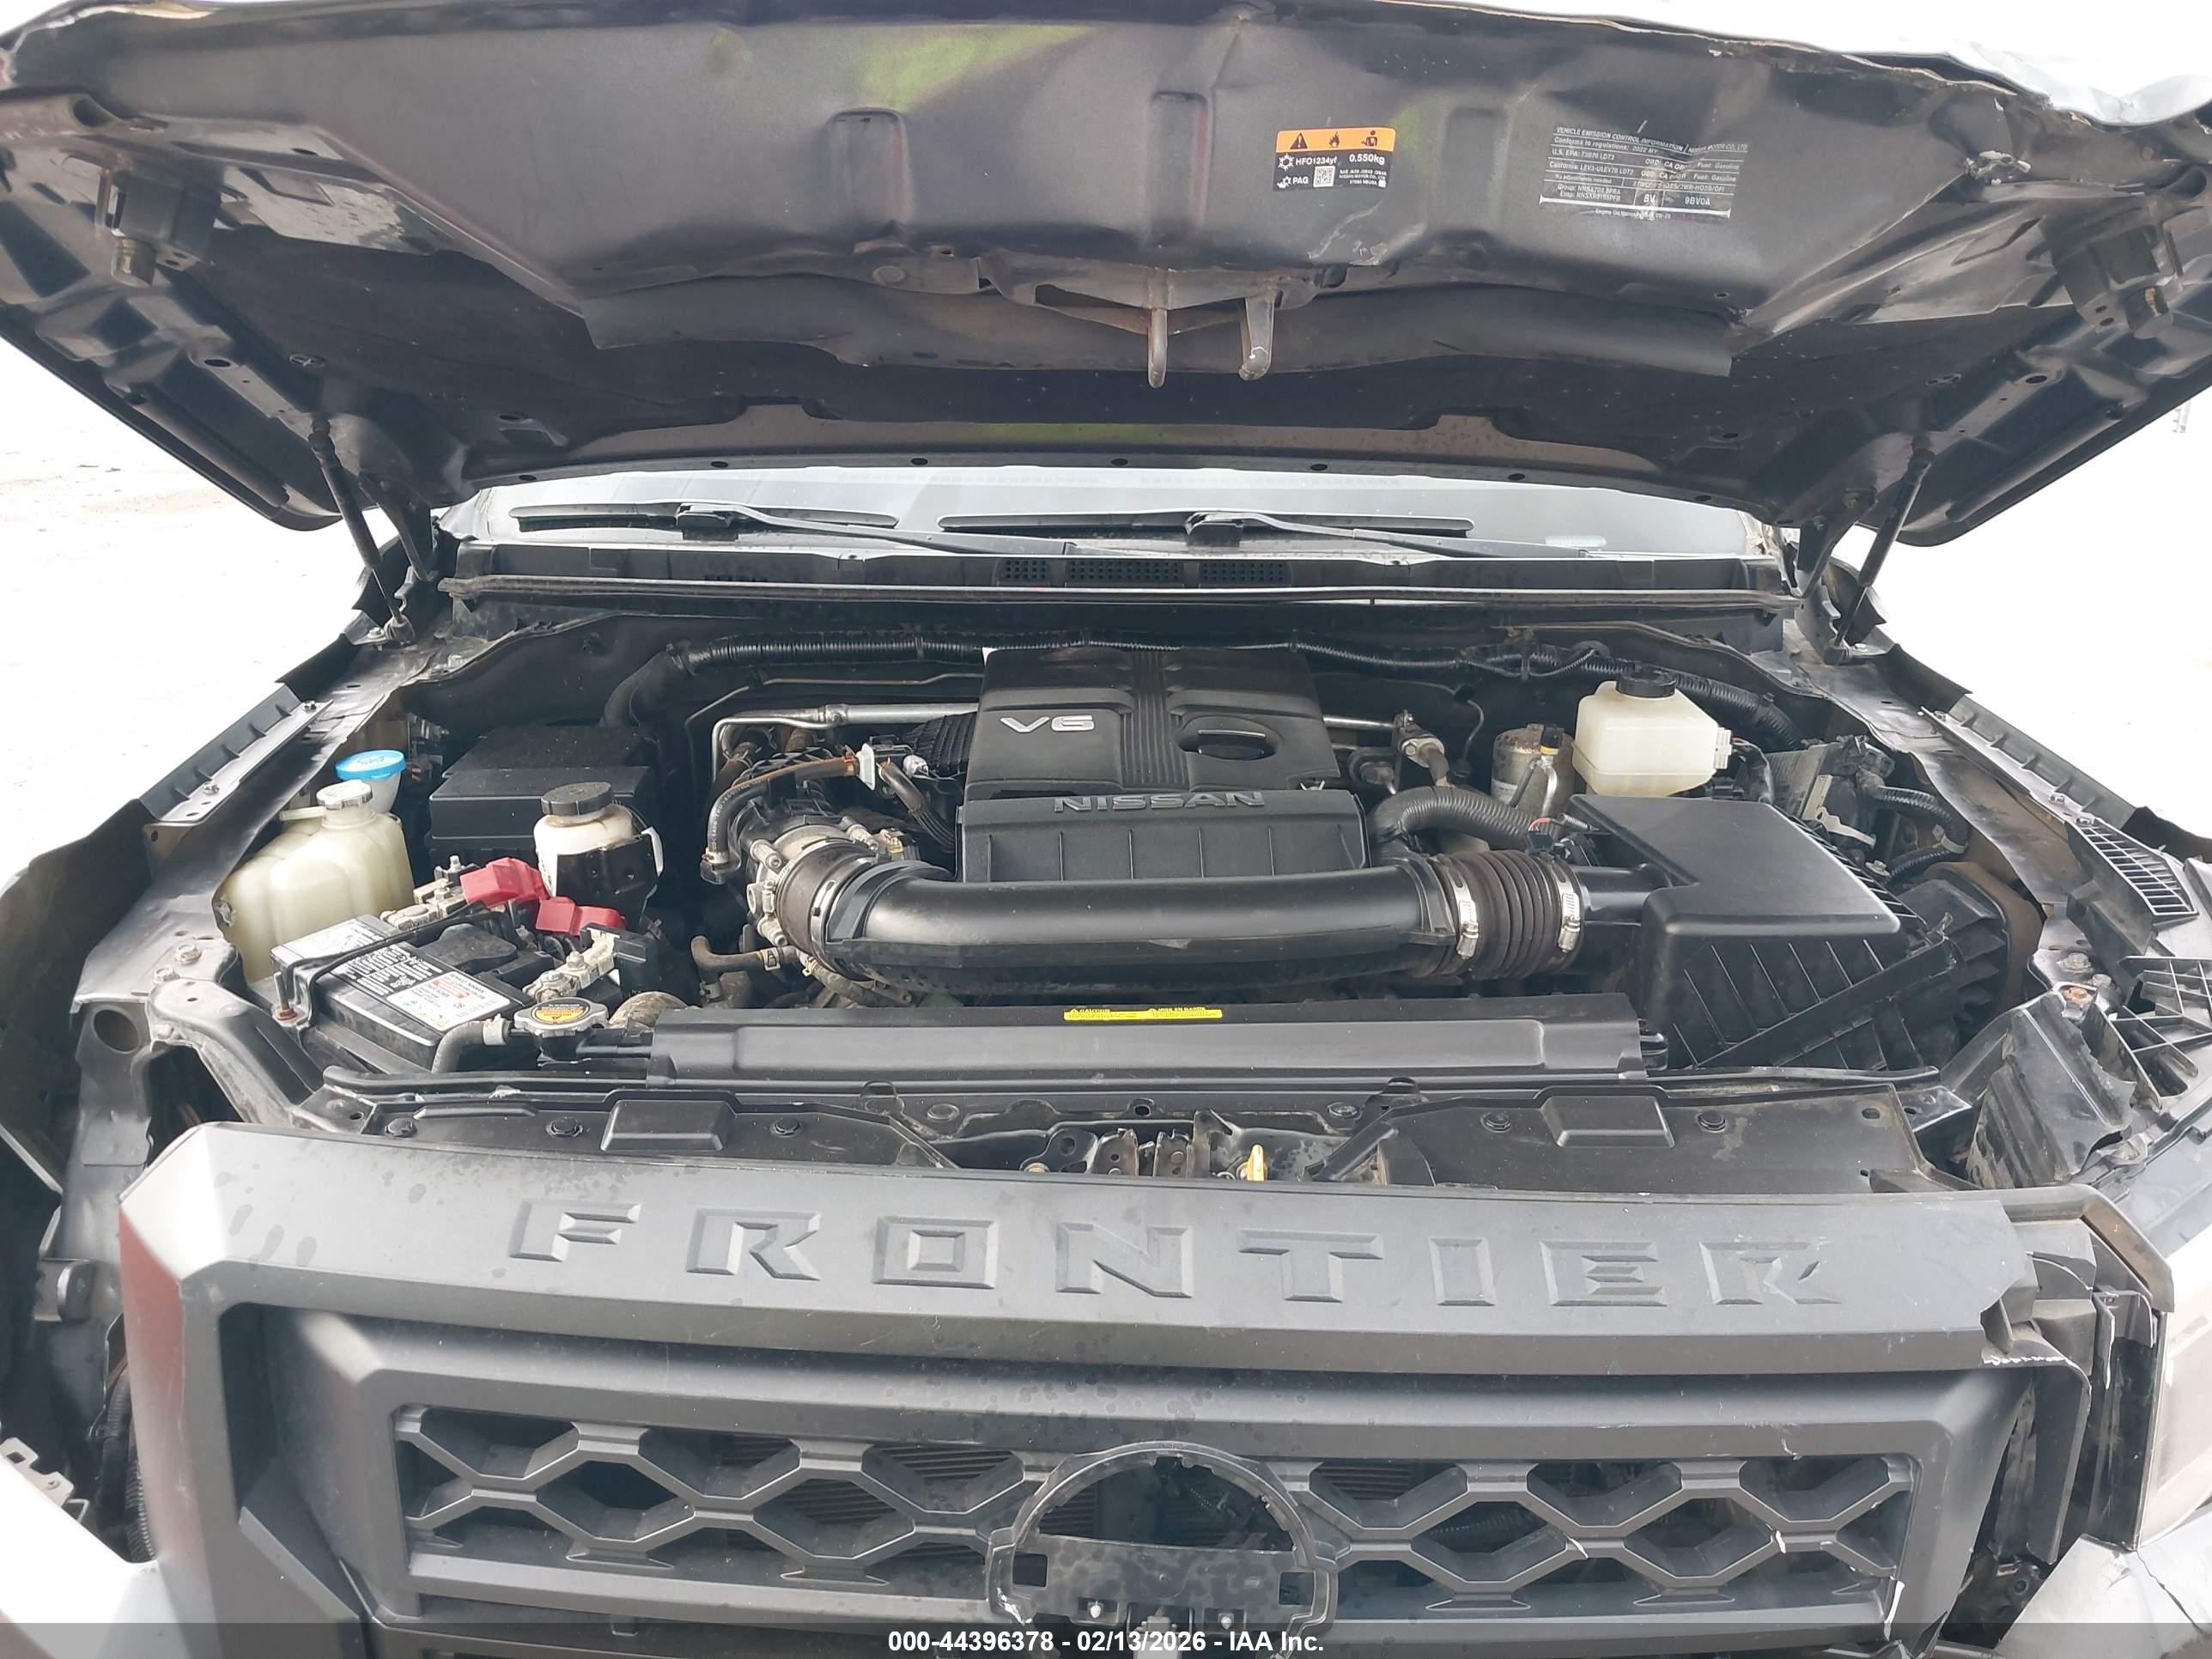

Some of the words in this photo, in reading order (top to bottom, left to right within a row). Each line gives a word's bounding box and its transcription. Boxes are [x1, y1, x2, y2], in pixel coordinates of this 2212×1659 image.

[1295, 156, 1338, 166] HFO1234yf
[1349, 153, 1385, 165] 0.550kg
[1292, 176, 1309, 185] PAG
[1000, 714, 1095, 733] V6
[1054, 791, 1267, 813] NISSAN
[509, 1202, 1842, 1307] FRONTIER
